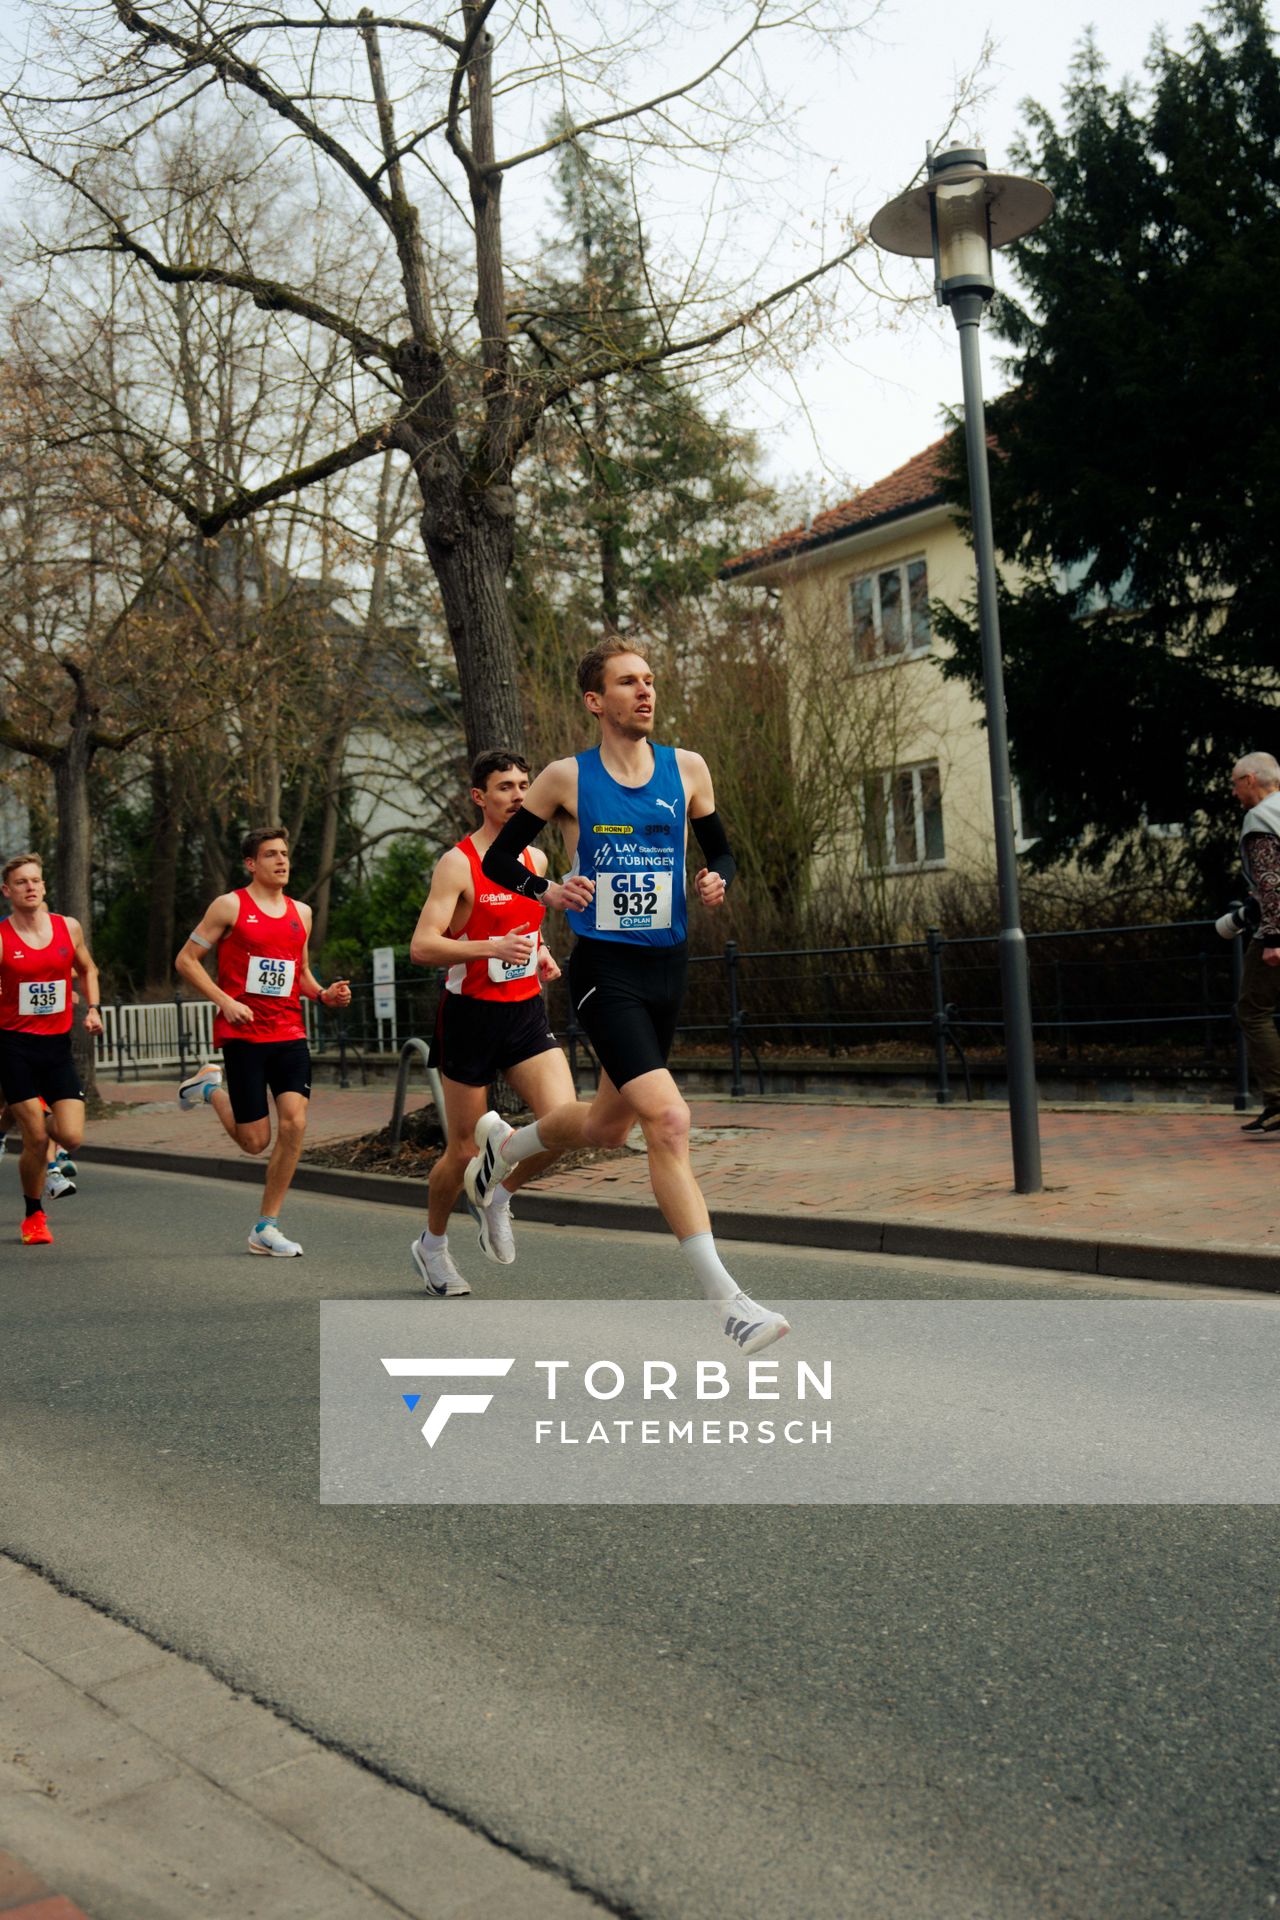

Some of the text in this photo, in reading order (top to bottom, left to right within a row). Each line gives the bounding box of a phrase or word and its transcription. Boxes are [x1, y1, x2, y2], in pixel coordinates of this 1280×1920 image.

[645, 825, 670, 835] gmg
[615, 843, 637, 853] LAV
[616, 854, 674, 866] TÜBINGEN
[611, 874, 656, 893] GLS
[490, 893, 513, 902] Brillux
[613, 893, 657, 915] 932
[259, 959, 286, 972] GLS
[258, 972, 286, 987] 436
[29, 982, 56, 994] GLS
[30, 993, 56, 1006] 435
